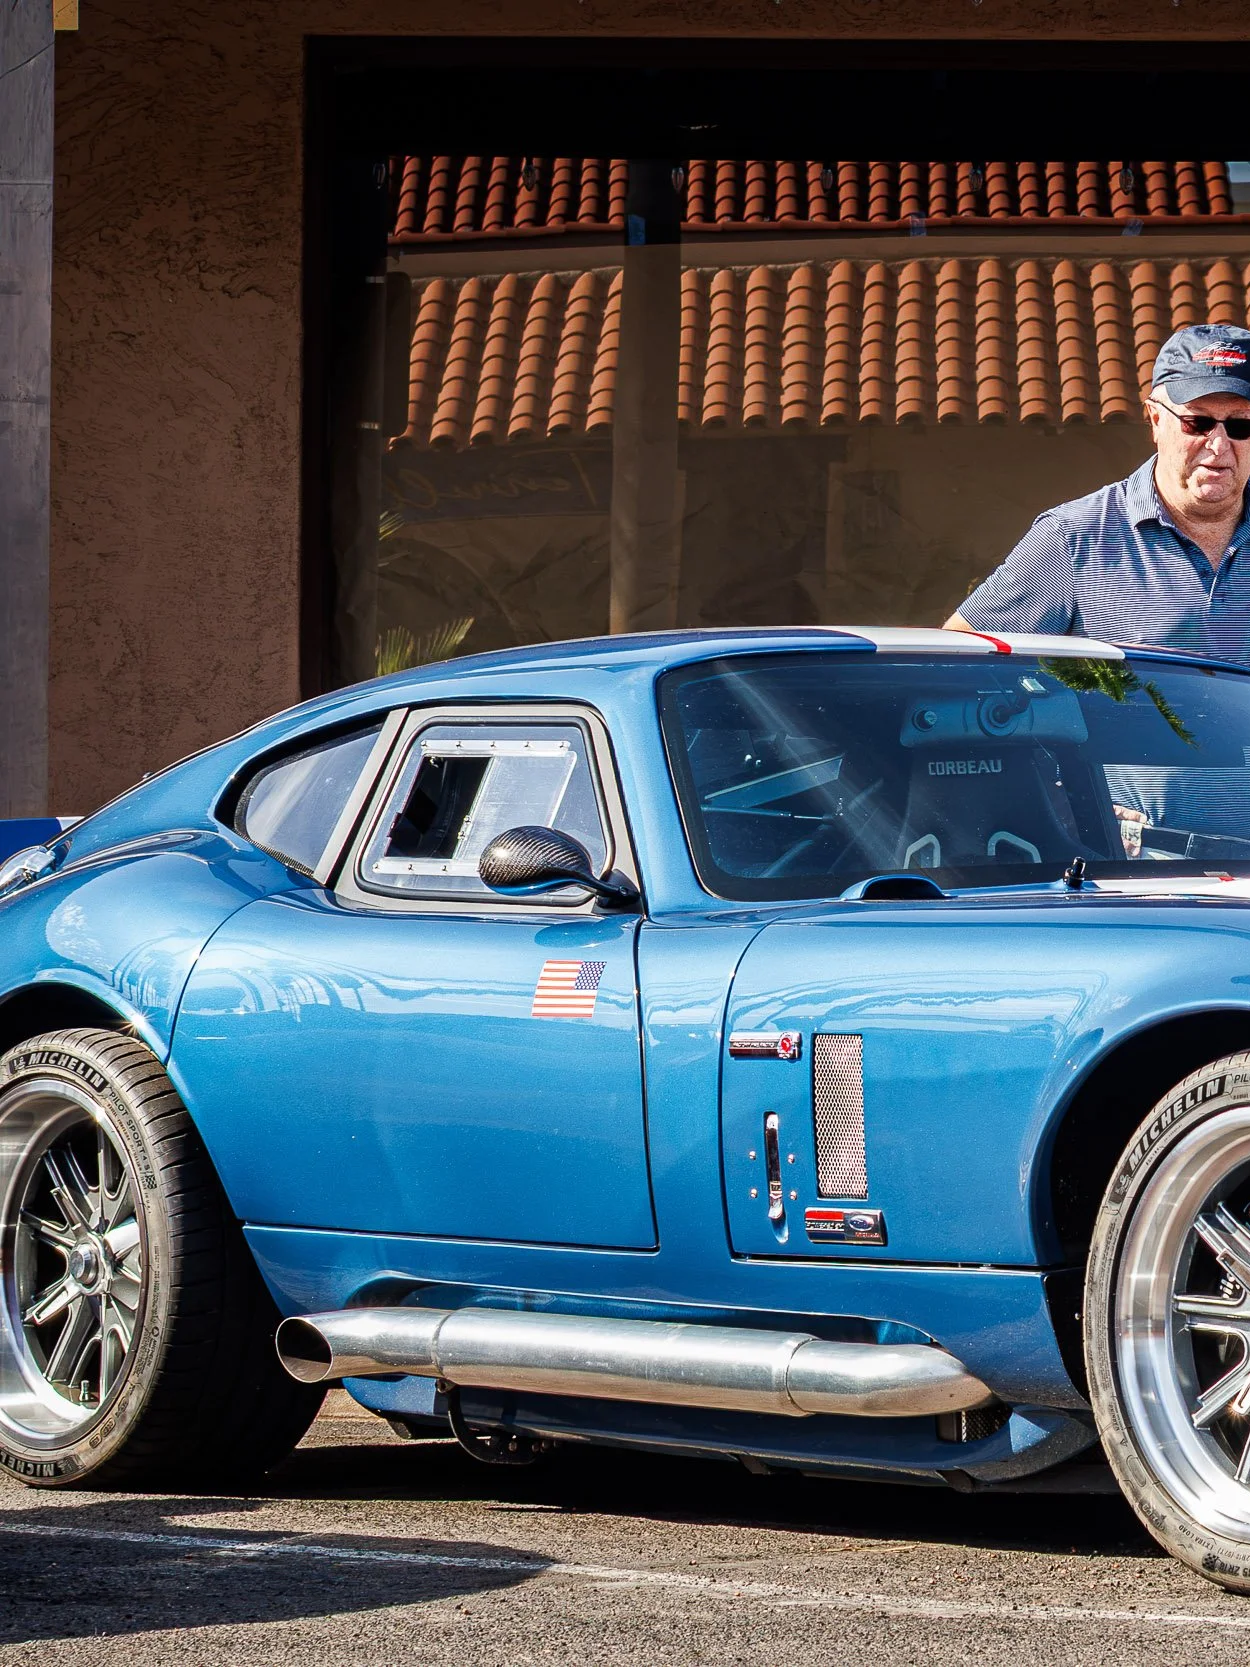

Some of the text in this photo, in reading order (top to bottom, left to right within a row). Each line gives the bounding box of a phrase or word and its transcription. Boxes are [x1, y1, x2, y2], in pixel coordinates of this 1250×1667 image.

[928, 759, 1002, 775] CORBEAU
[28, 1052, 105, 1088] MICHELIN
[108, 1091, 129, 1117] PILOT
[126, 1120, 146, 1154] SPORT
[1128, 1078, 1221, 1171] MICHELIN
